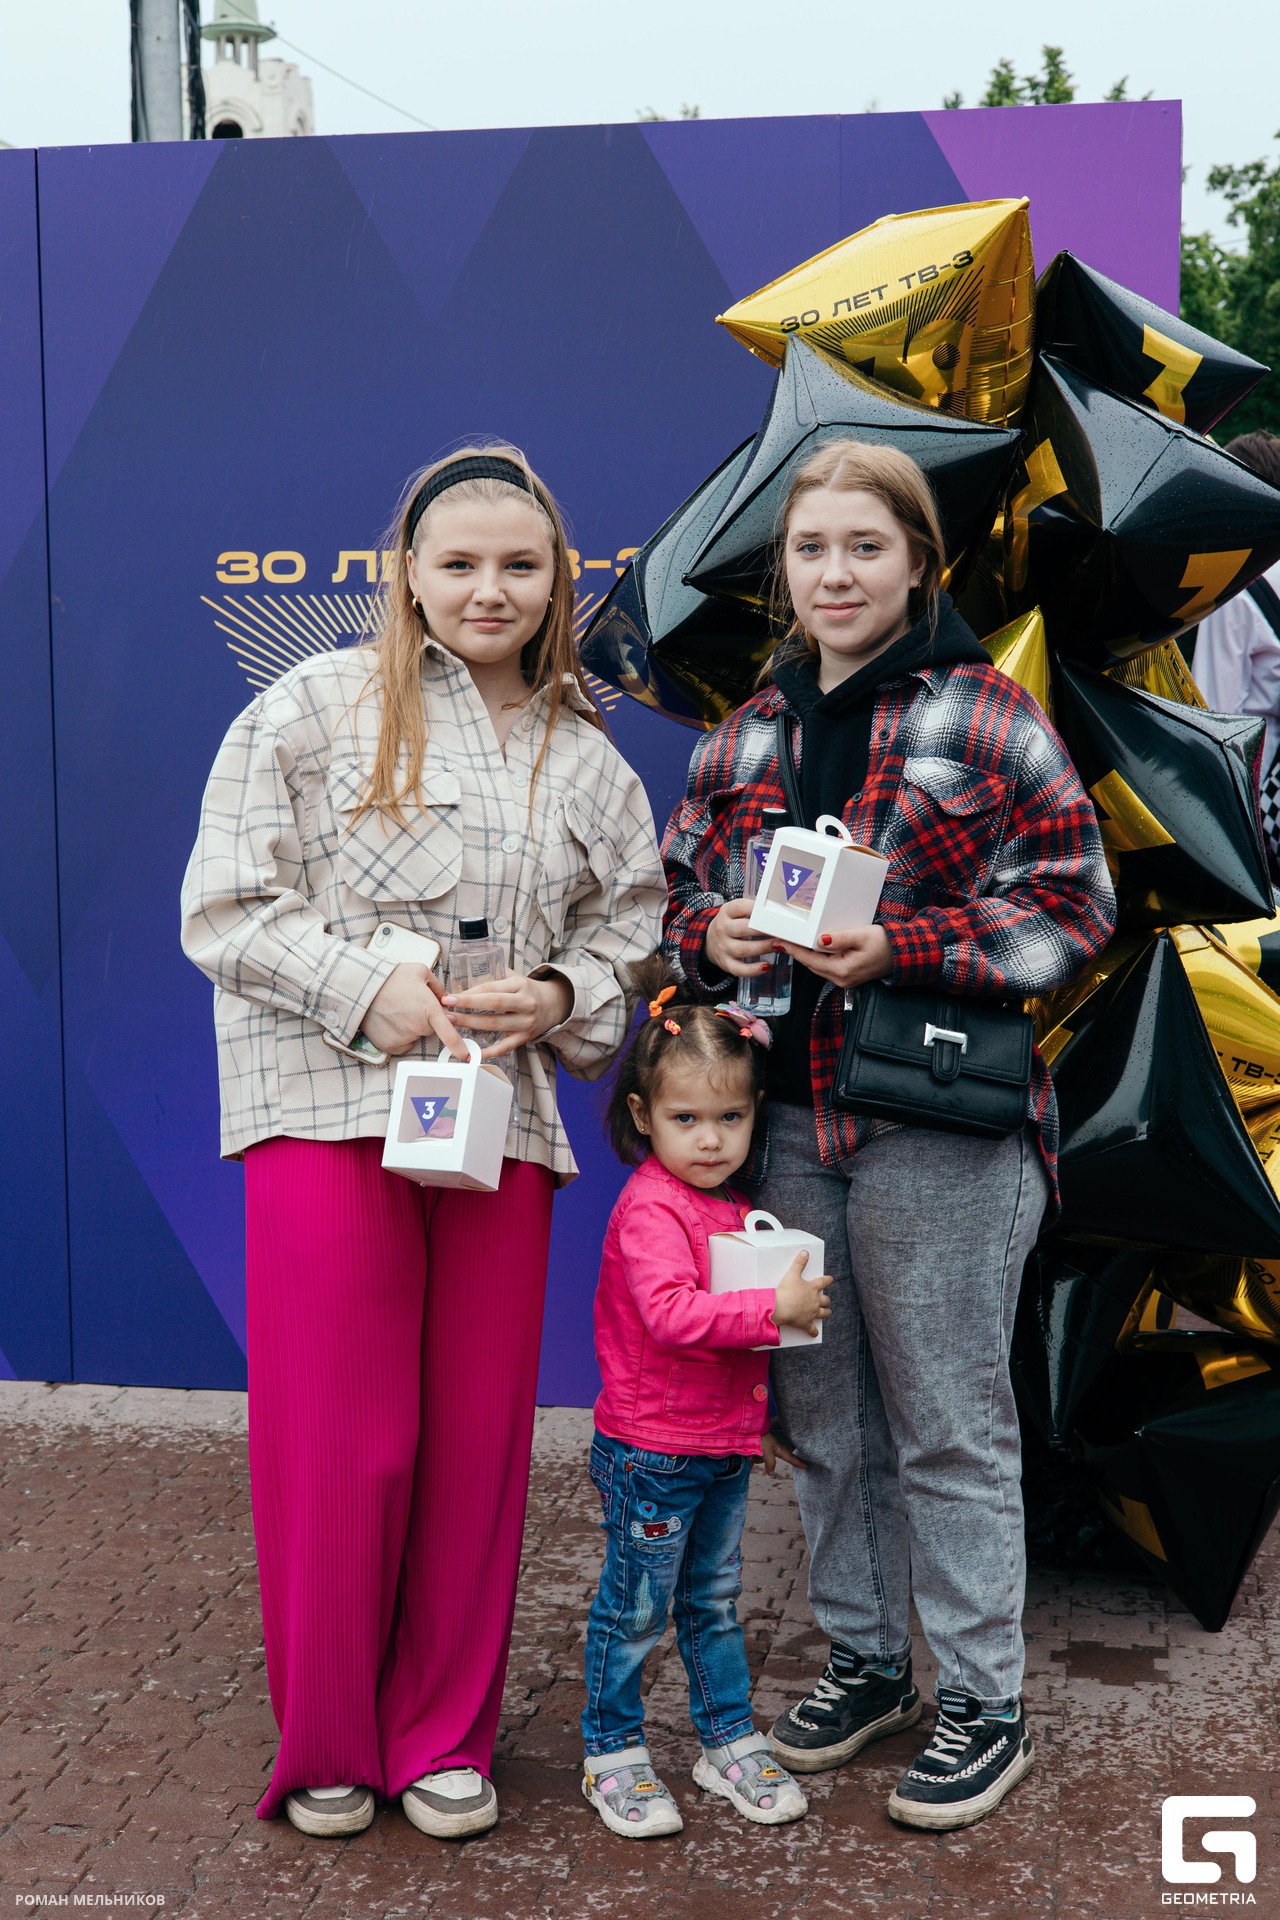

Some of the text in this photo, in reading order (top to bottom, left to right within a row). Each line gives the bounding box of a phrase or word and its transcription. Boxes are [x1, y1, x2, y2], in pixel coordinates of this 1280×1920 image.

[780, 249, 975, 333] 30 ЛЕТ ТВ-3
[215, 550, 307, 584] 30
[788, 869, 802, 886] 3
[421, 1101, 436, 1120] 3
